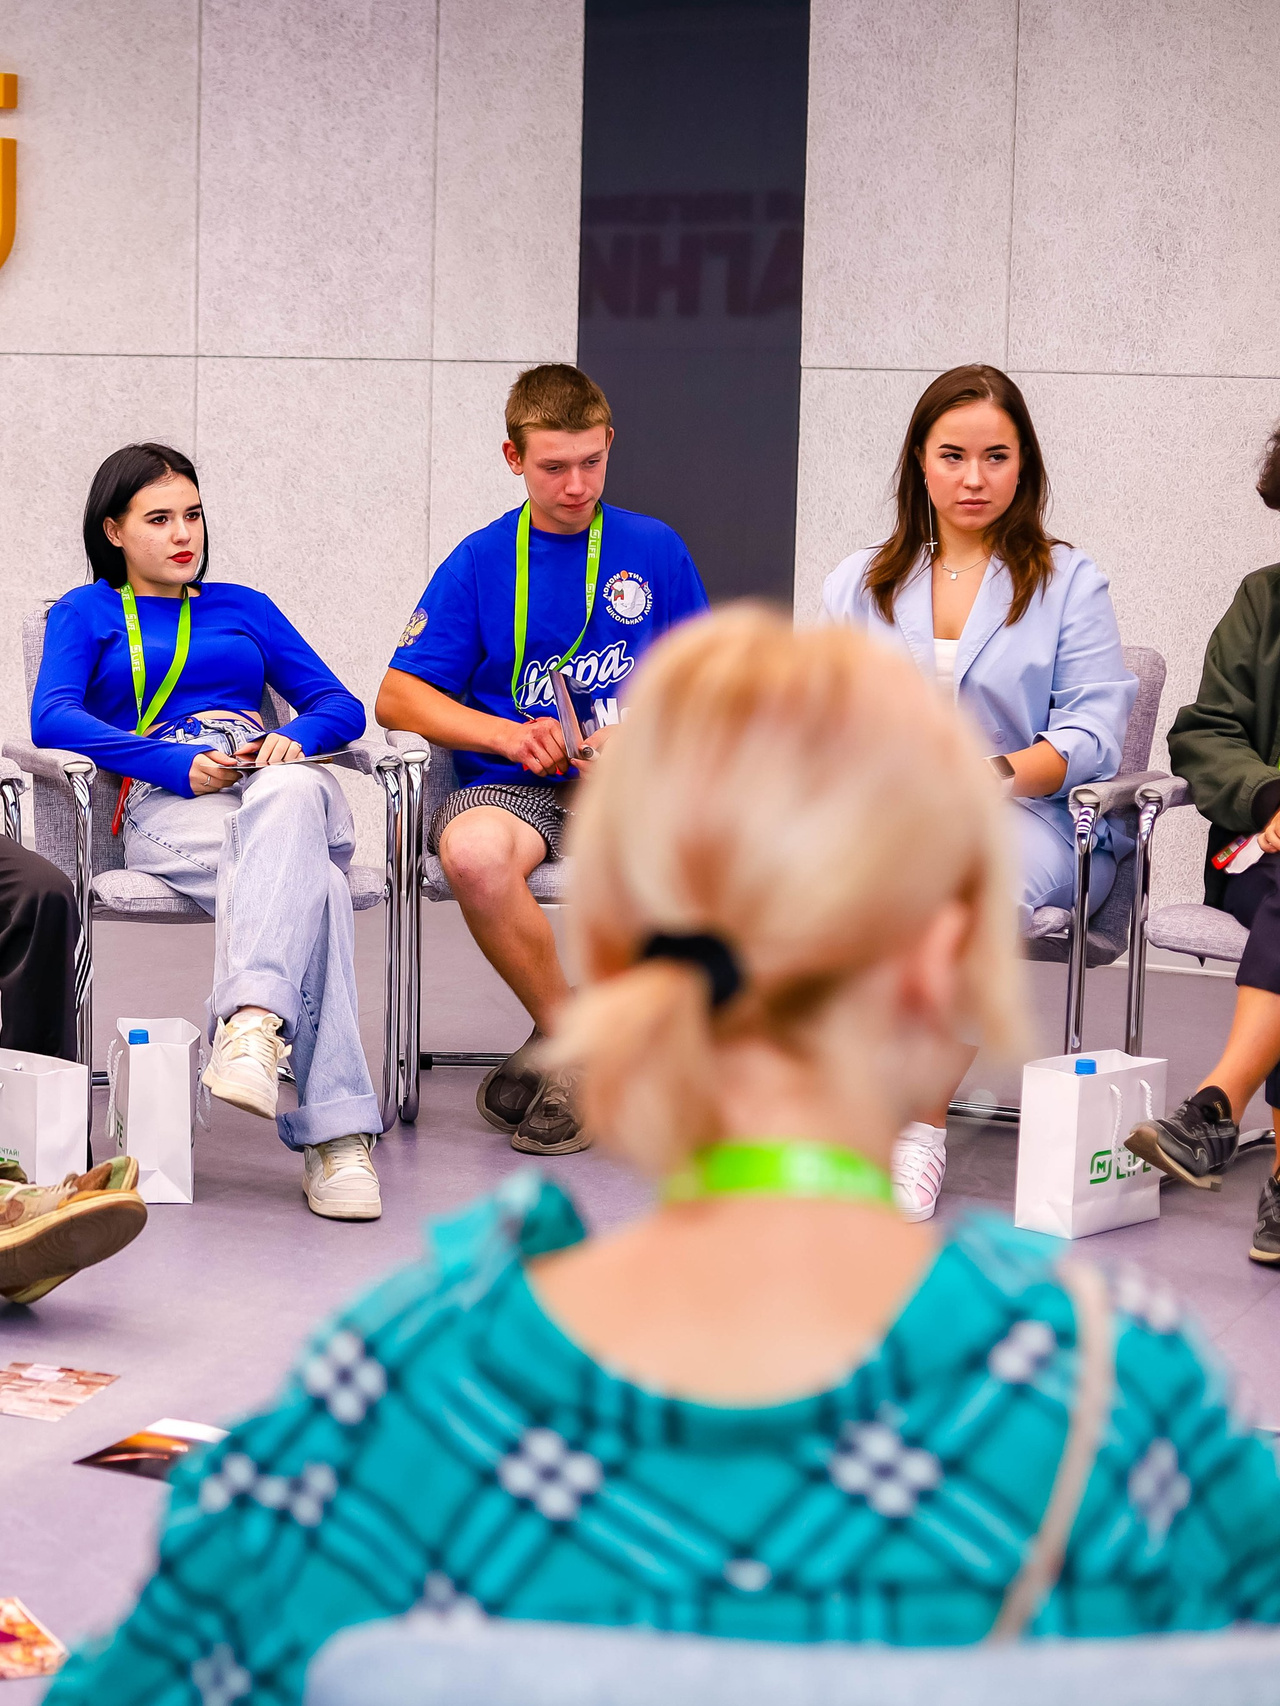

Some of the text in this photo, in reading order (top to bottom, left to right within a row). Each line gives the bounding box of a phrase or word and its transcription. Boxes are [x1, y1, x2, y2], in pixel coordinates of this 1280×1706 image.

[644, 594, 653, 615] ЛИГА
[606, 605, 643, 625] ШКОЛЬНАЯ
[132, 654, 140, 672] LIFE
